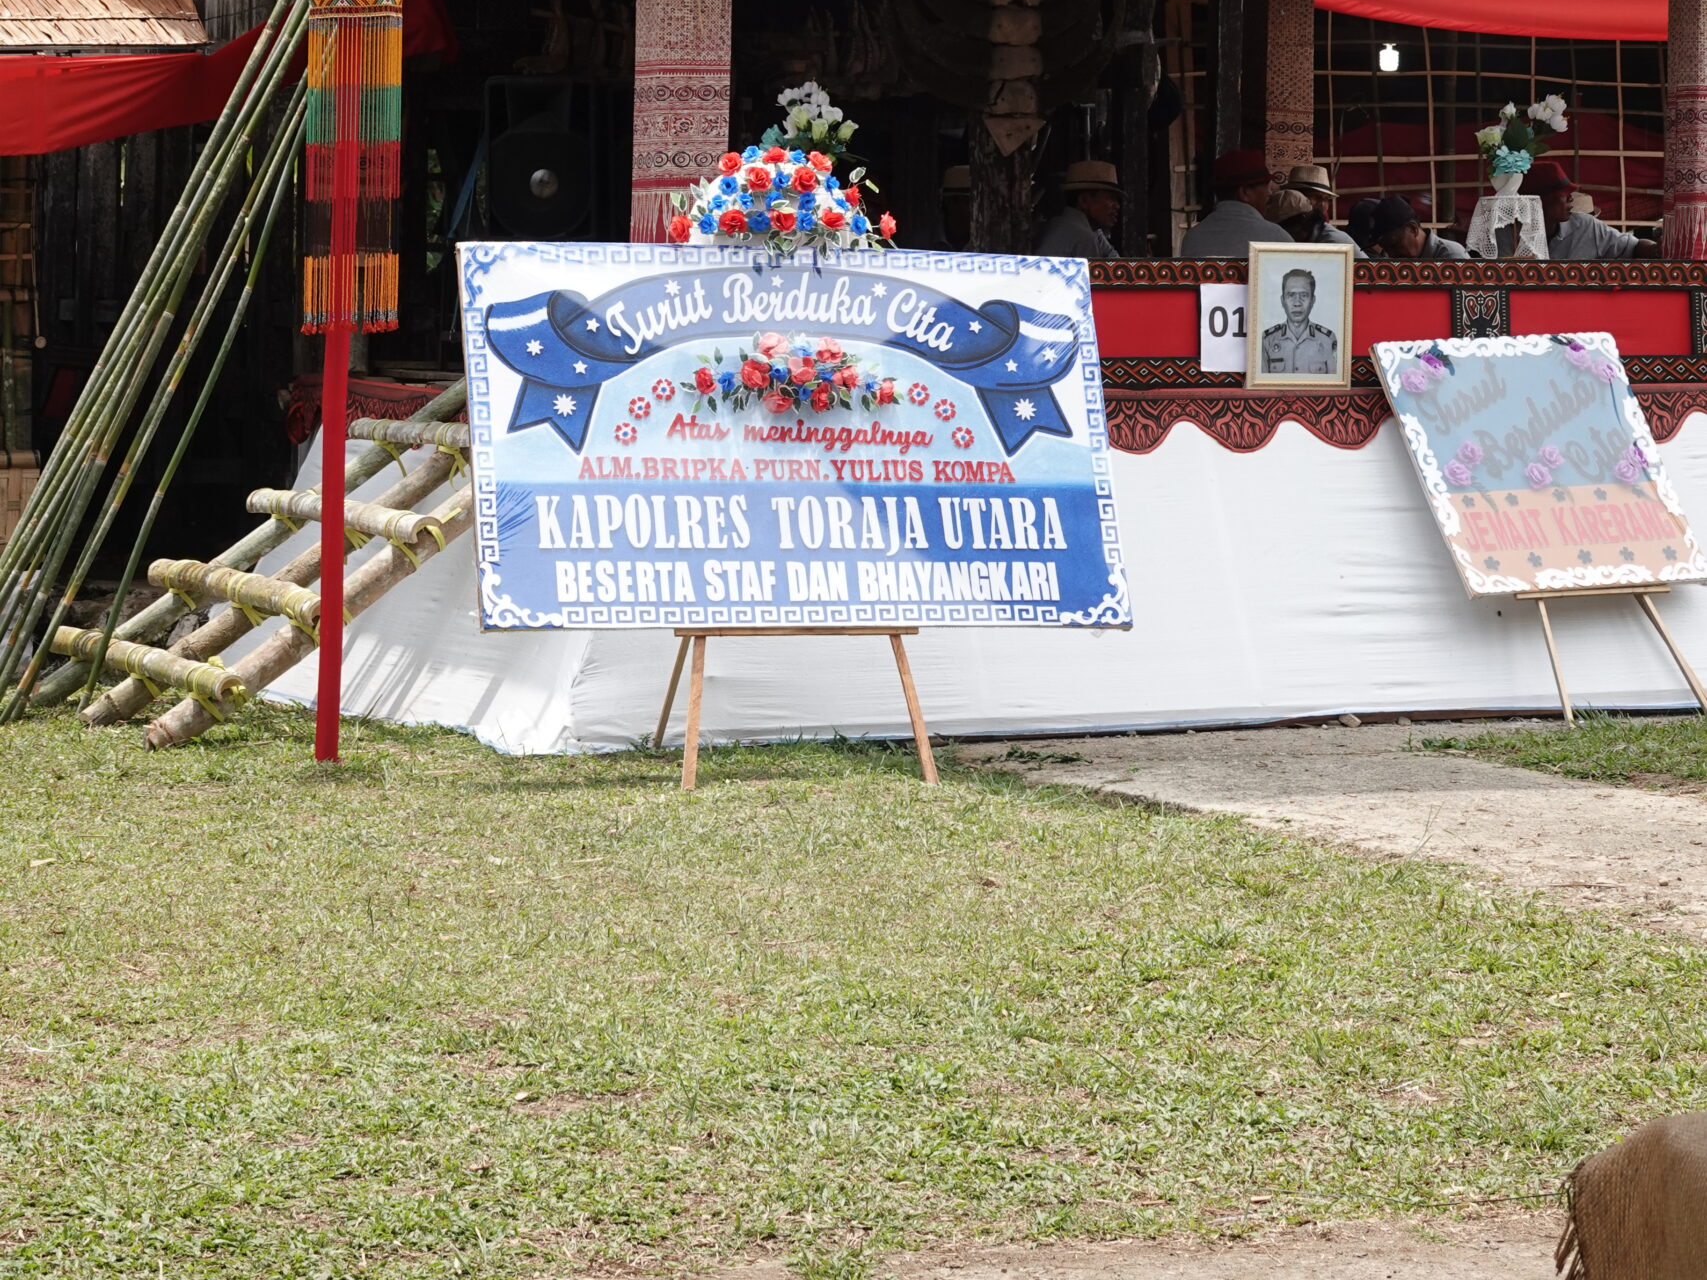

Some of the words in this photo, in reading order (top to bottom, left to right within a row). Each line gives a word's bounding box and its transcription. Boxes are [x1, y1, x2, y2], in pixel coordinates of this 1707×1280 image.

[606, 279, 712, 354] Turut
[722, 272, 877, 326] Berduka
[886, 288, 955, 352] Cita
[1208, 305, 1247, 338] 01
[667, 413, 731, 441] Atas
[743, 418, 934, 455] meninggalnya
[932, 460, 1016, 483] KOMPA
[536, 493, 751, 550] KAPOLRES
[771, 495, 929, 556] TORAJA
[938, 497, 1068, 550] UTARA
[1462, 508, 1551, 552] JEMAAT
[555, 559, 697, 603] BESERTA
[703, 559, 777, 602] STAF
[785, 560, 850, 602] DAN
[857, 560, 1060, 602] BHAYANGKARI
